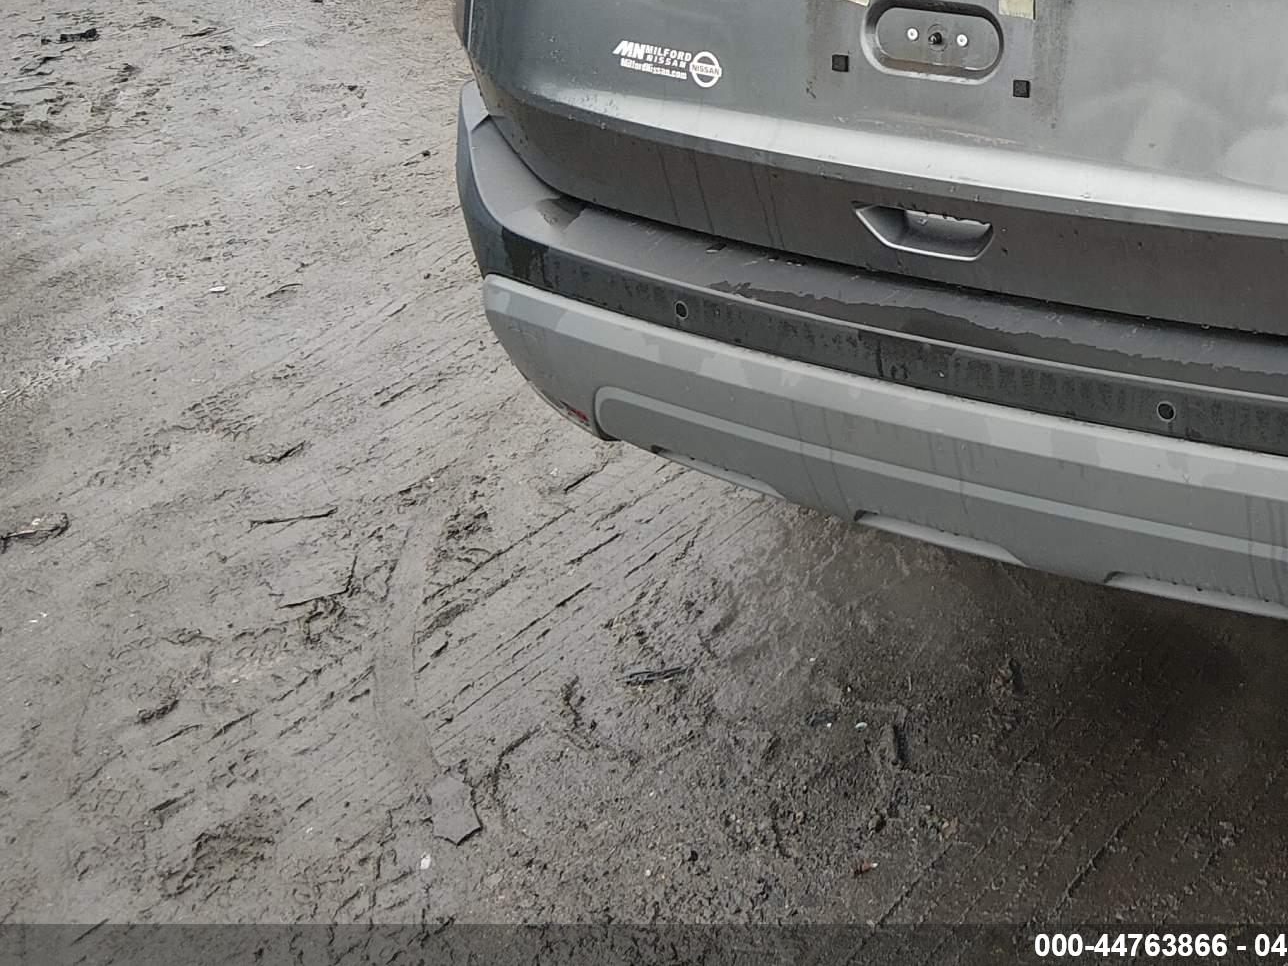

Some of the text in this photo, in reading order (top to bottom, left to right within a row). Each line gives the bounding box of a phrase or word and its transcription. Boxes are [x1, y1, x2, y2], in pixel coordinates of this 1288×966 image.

[646, 44, 693, 62] MILFORD
[646, 53, 687, 69] NISSAN
[691, 63, 720, 76] NISSAN
